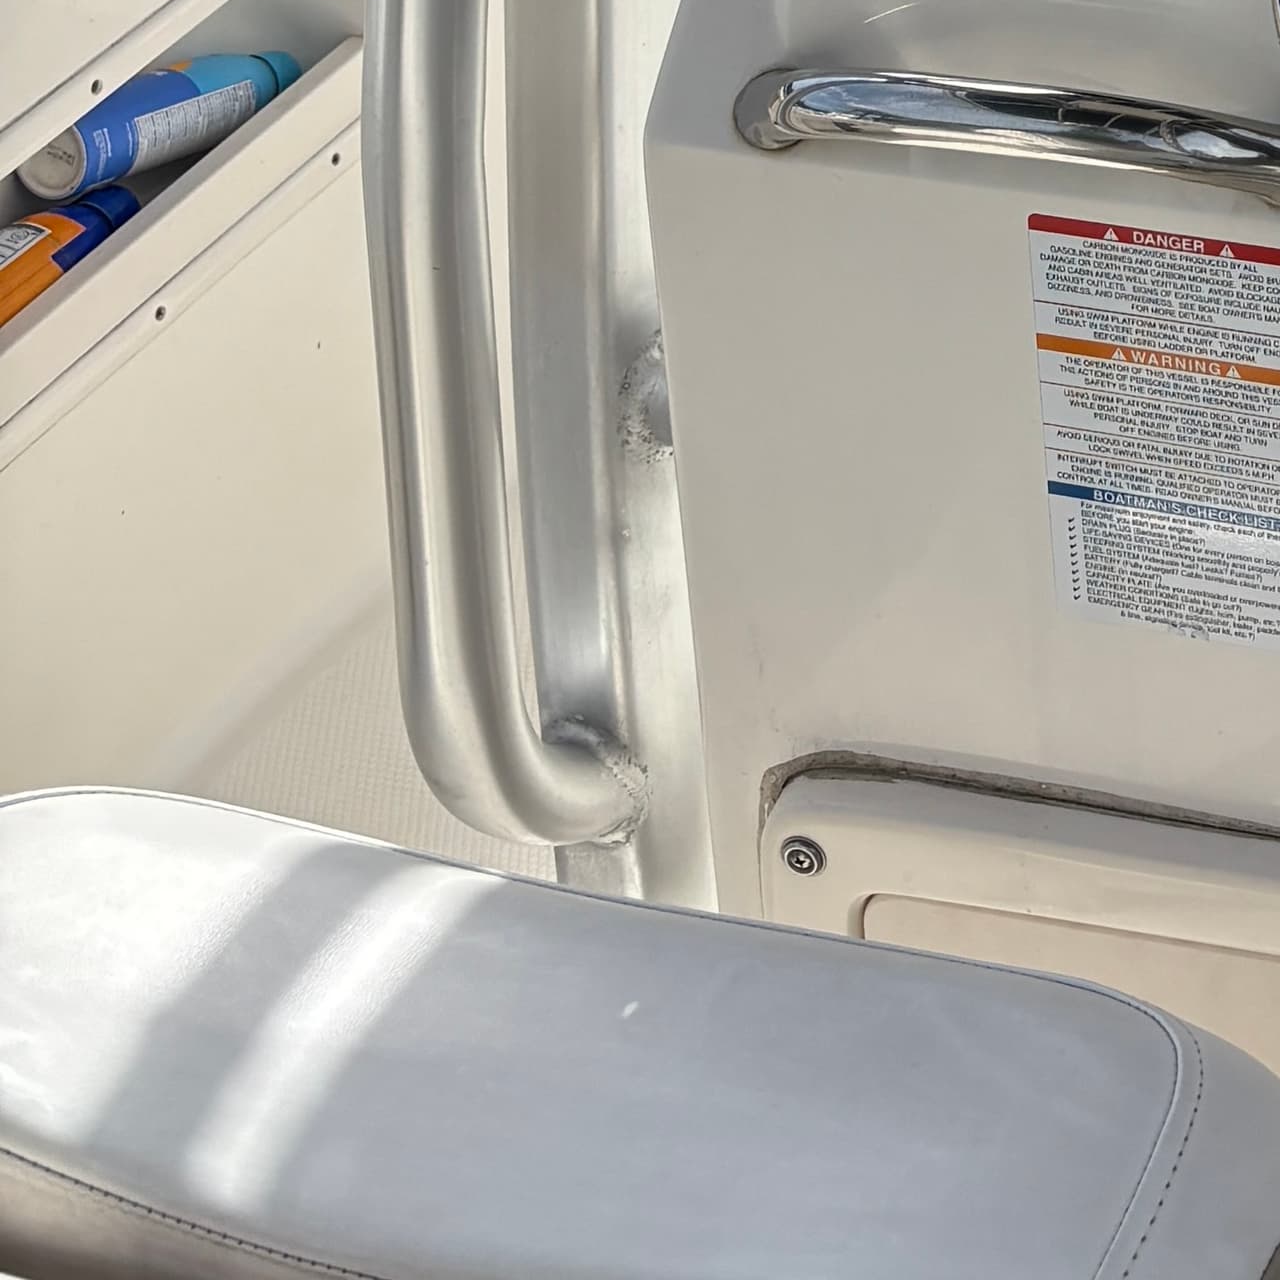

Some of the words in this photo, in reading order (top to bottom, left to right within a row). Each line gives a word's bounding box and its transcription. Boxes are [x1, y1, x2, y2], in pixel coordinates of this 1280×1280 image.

[1132, 230, 1205, 253] DANGER
[1130, 350, 1221, 375] WARNING
[1093, 489, 1182, 513] BOATMAN'S
[1186, 502, 1239, 524] CHECK
[1244, 515, 1276, 531] LIST
